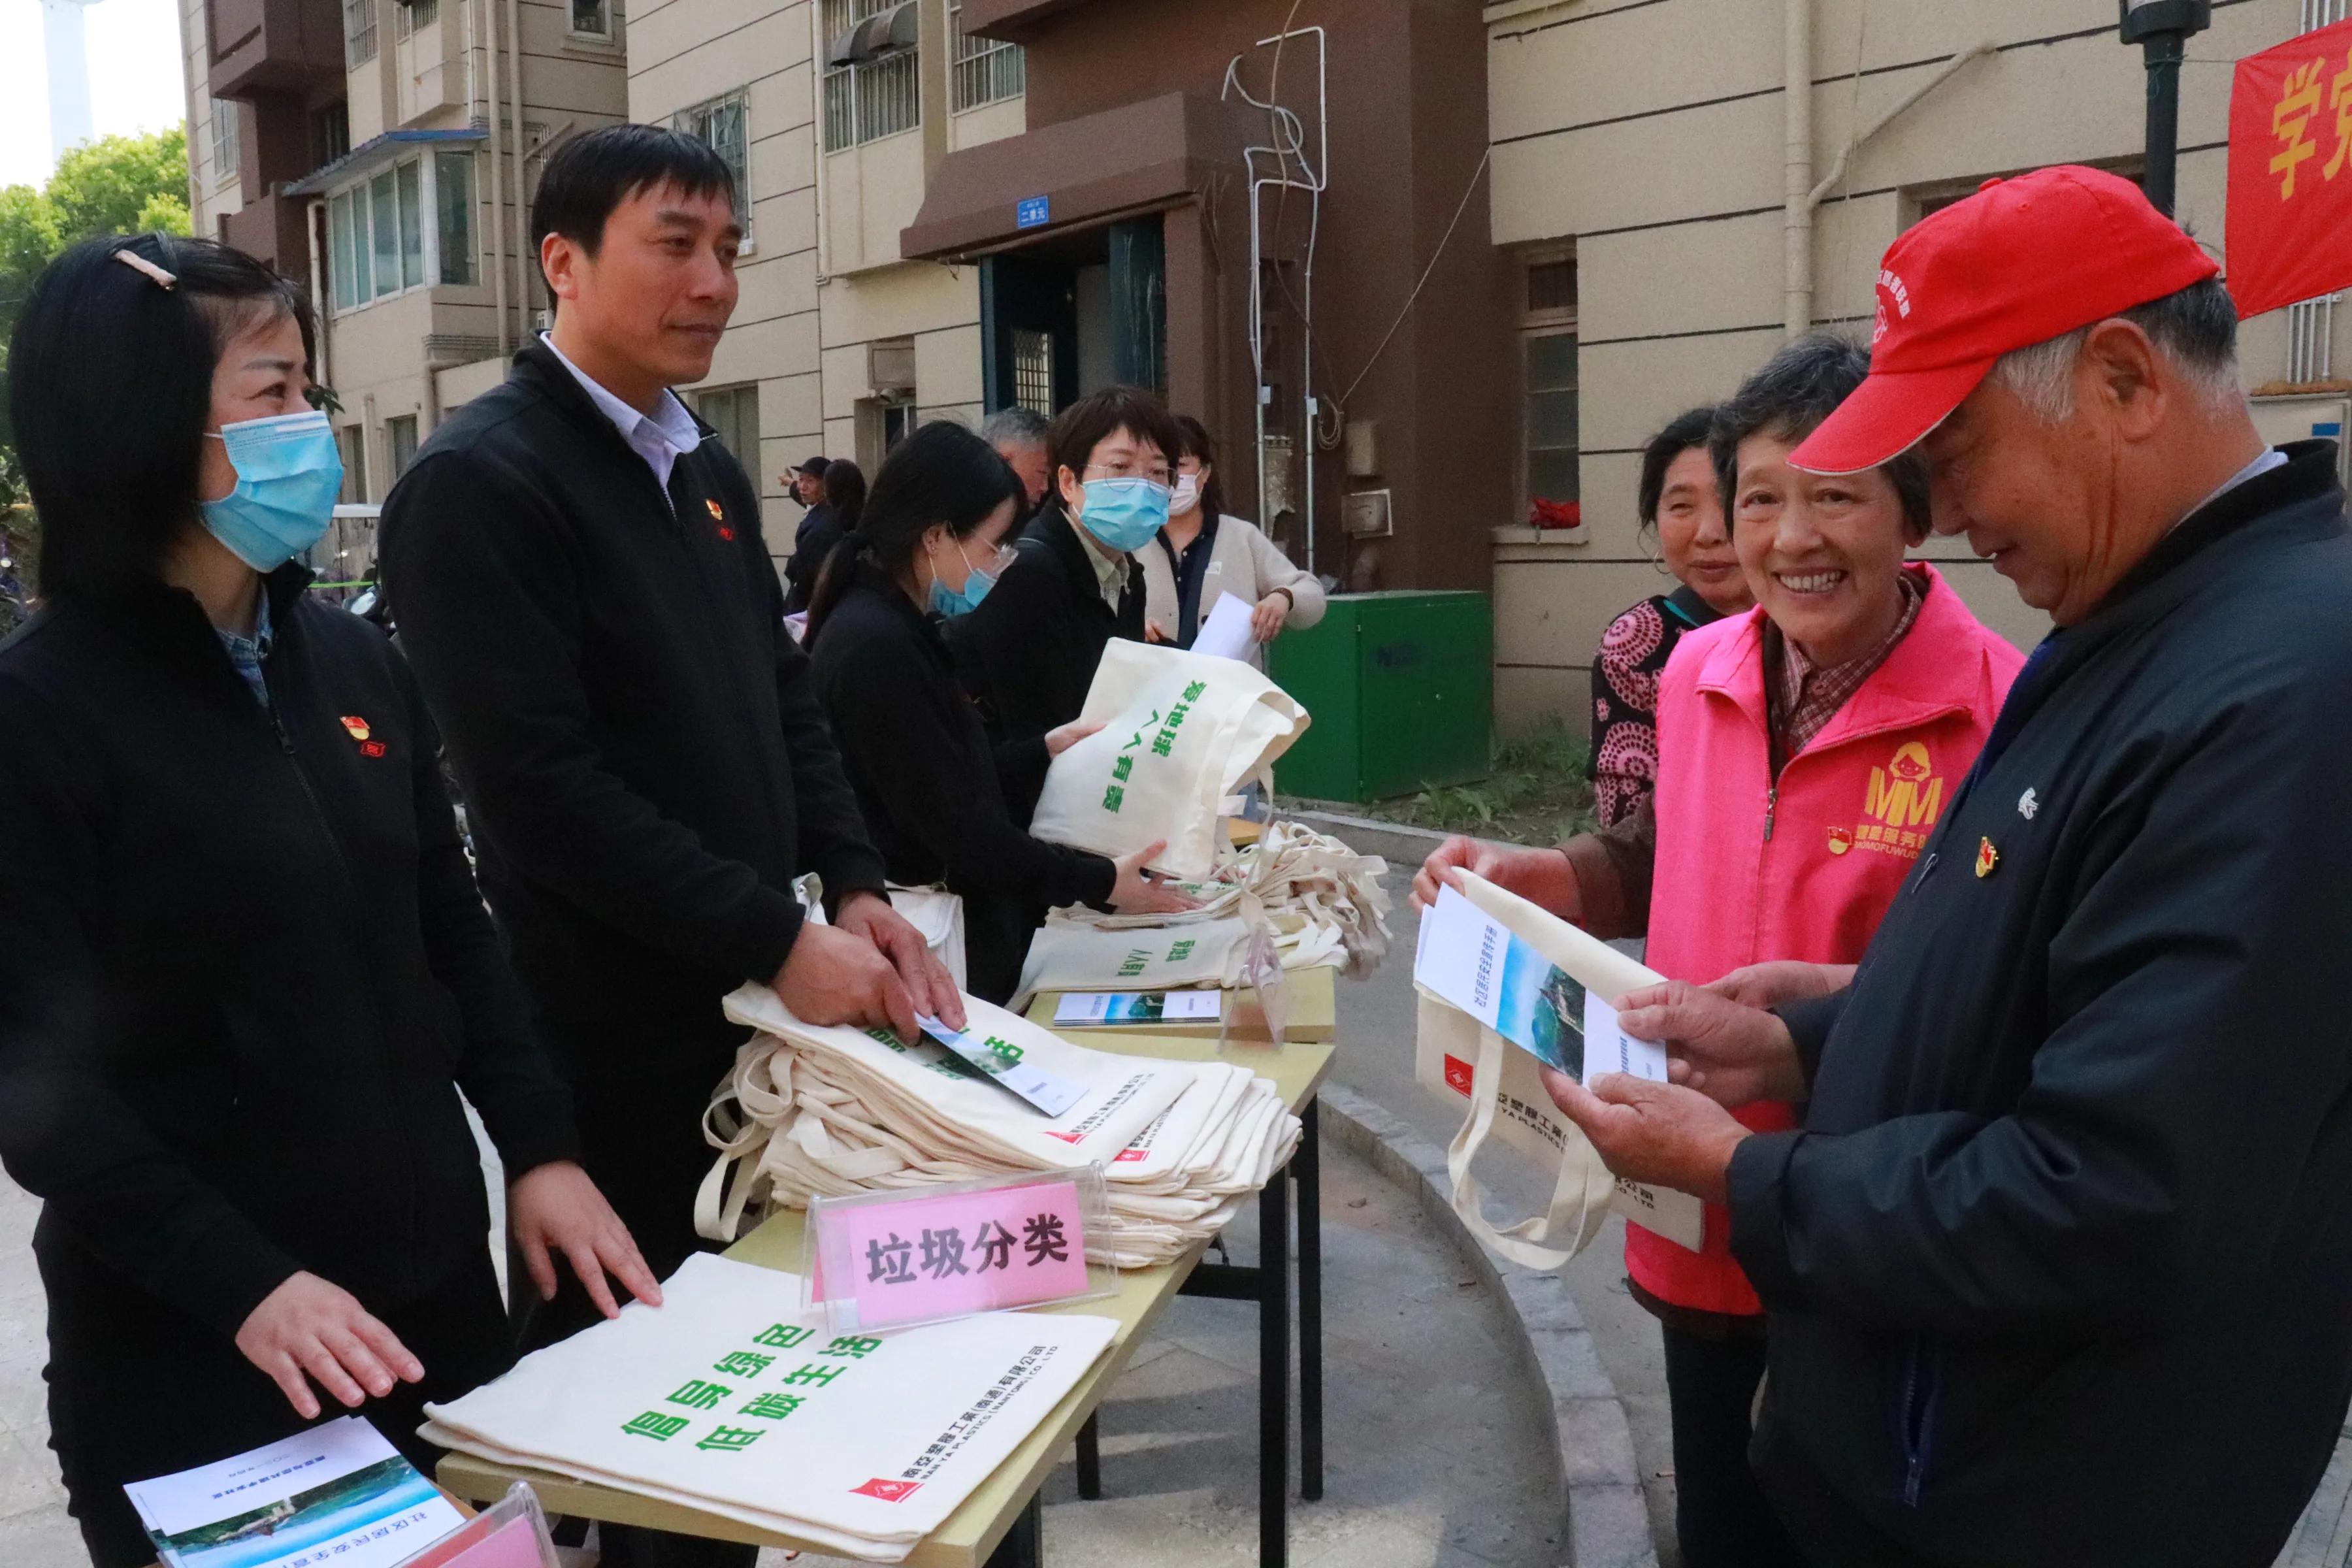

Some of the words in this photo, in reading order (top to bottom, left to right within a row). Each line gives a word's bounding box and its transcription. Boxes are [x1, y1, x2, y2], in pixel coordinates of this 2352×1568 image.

[1151, 679, 1207, 758] 爱地球
[1102, 709, 1160, 813] 人人有责
[1474, 924, 1498, 1008] 社区居民安全宣传手册
[864, 1213, 1070, 1286] 垃圾分类
[621, 1323, 816, 1442] 倡导绿色
[695, 1335, 883, 1452] 低碳生活
[920, 1464, 941, 1480] NAN
[941, 1451, 954, 1463] YA
[953, 1414, 992, 1450] PLASTICS
[282, 1512, 428, 1568] 社区居民安全宣
